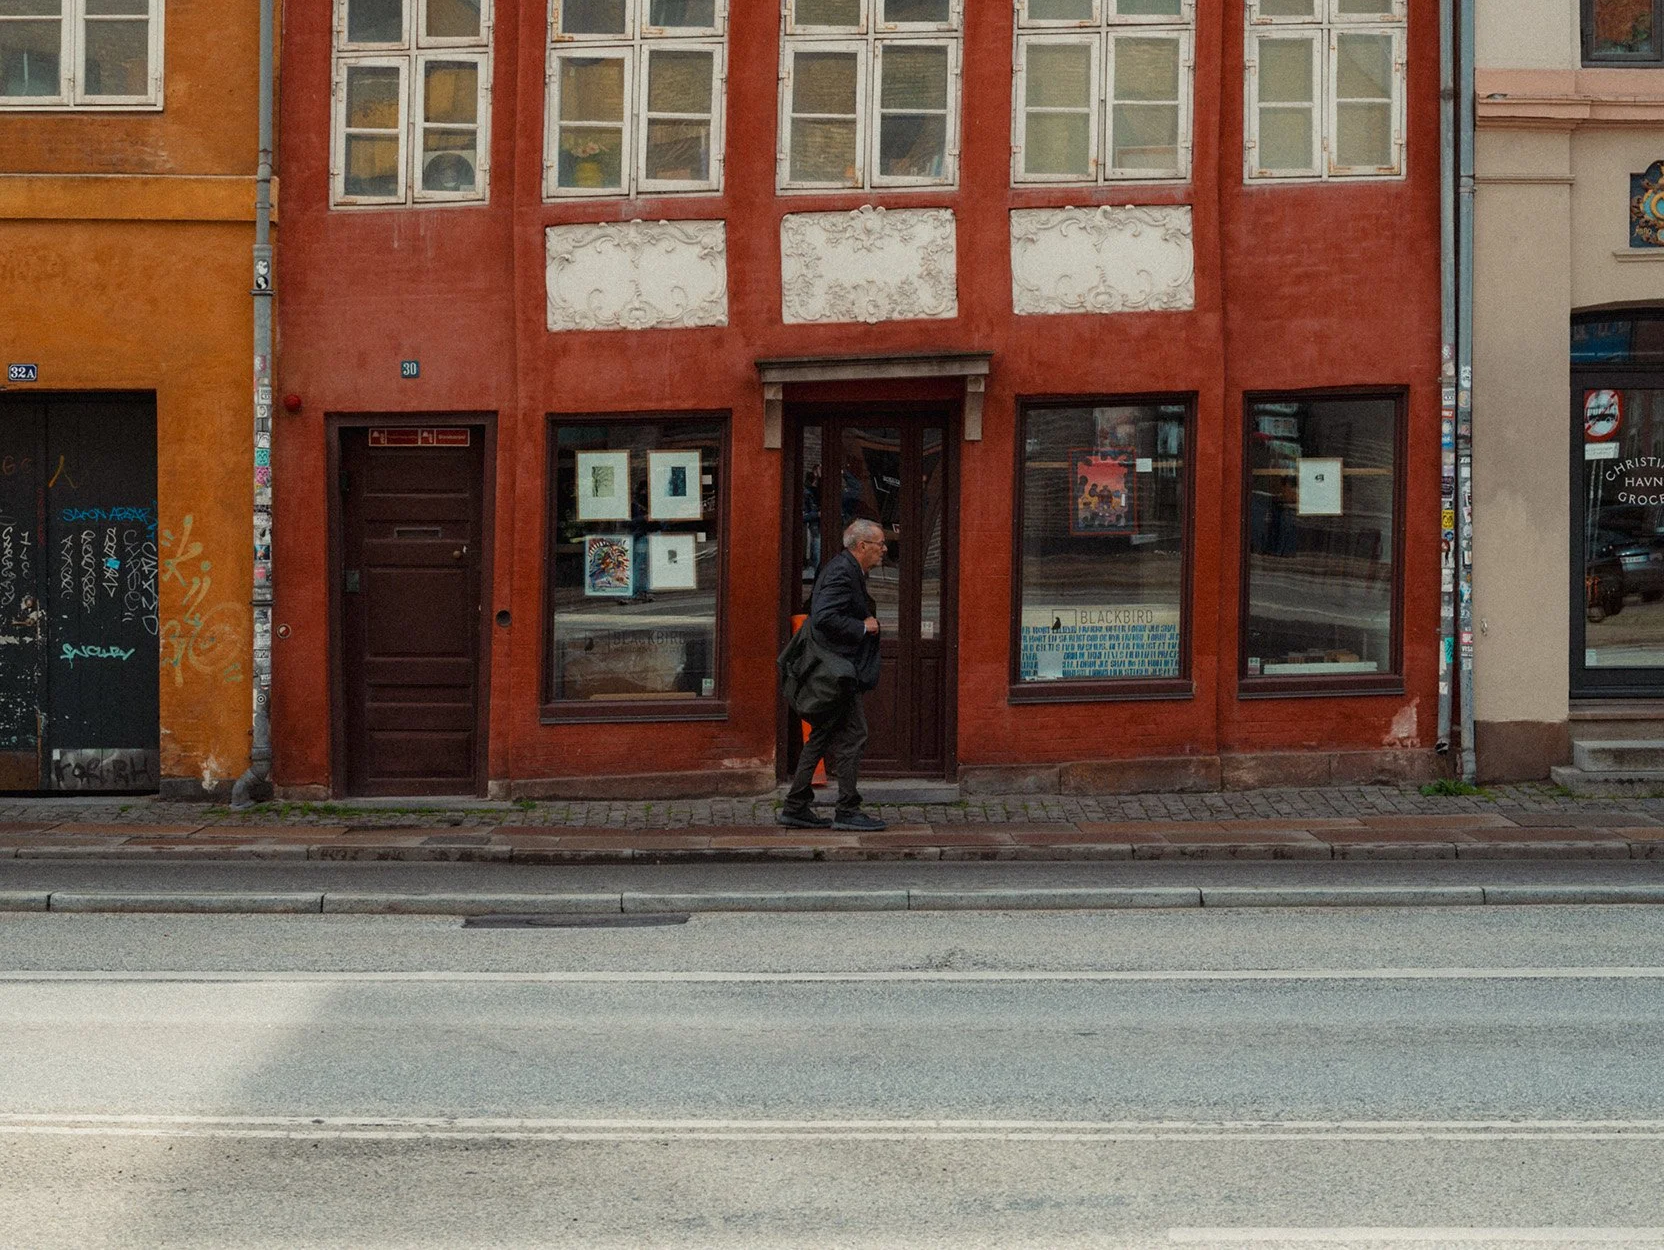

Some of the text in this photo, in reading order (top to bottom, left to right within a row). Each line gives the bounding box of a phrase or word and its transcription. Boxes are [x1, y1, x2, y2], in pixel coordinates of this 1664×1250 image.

[10, 366, 35, 378] 32A
[403, 362, 417, 376] 30
[1625, 477, 1663, 487] HAVN
[1081, 610, 1153, 624] BLACKBIRD
